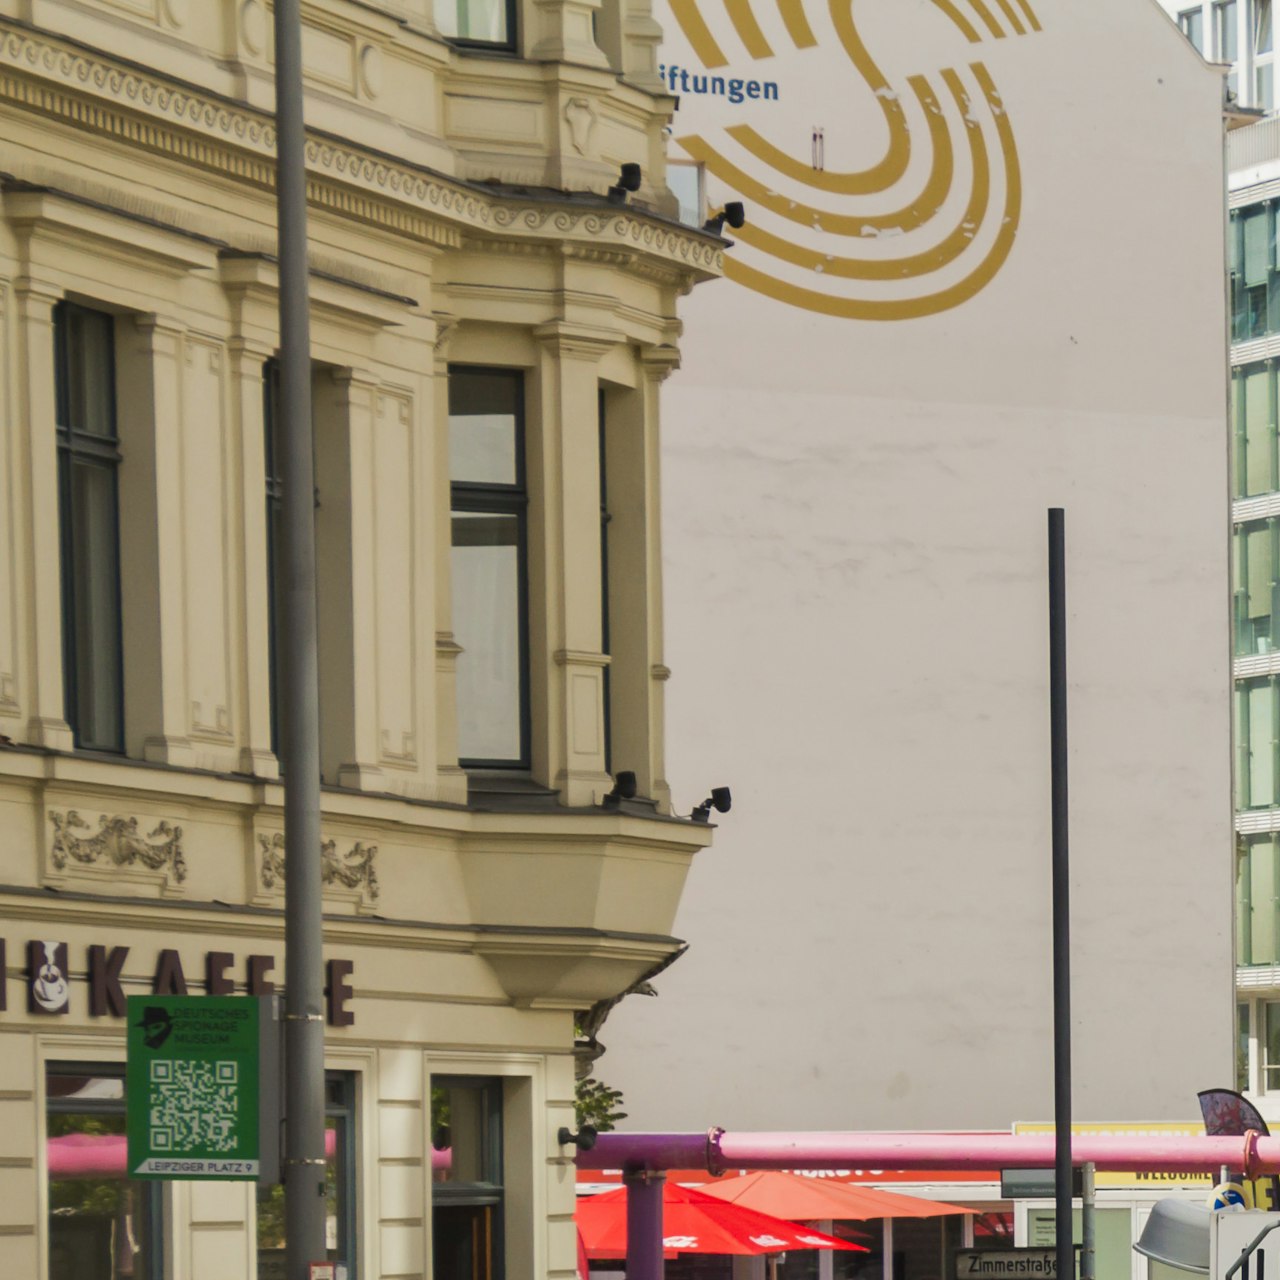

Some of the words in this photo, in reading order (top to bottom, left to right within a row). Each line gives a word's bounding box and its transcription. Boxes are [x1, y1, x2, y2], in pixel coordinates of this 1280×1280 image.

[88, 943, 356, 1027] KAFFE
[174, 1034, 230, 1045] MUSEUM
[148, 1161, 203, 1171] LEIPZIGER
[208, 1162, 242, 1172] PLATZ
[246, 1163, 253, 1172] 9
[968, 1255, 1058, 1275] Zimmerstraße
